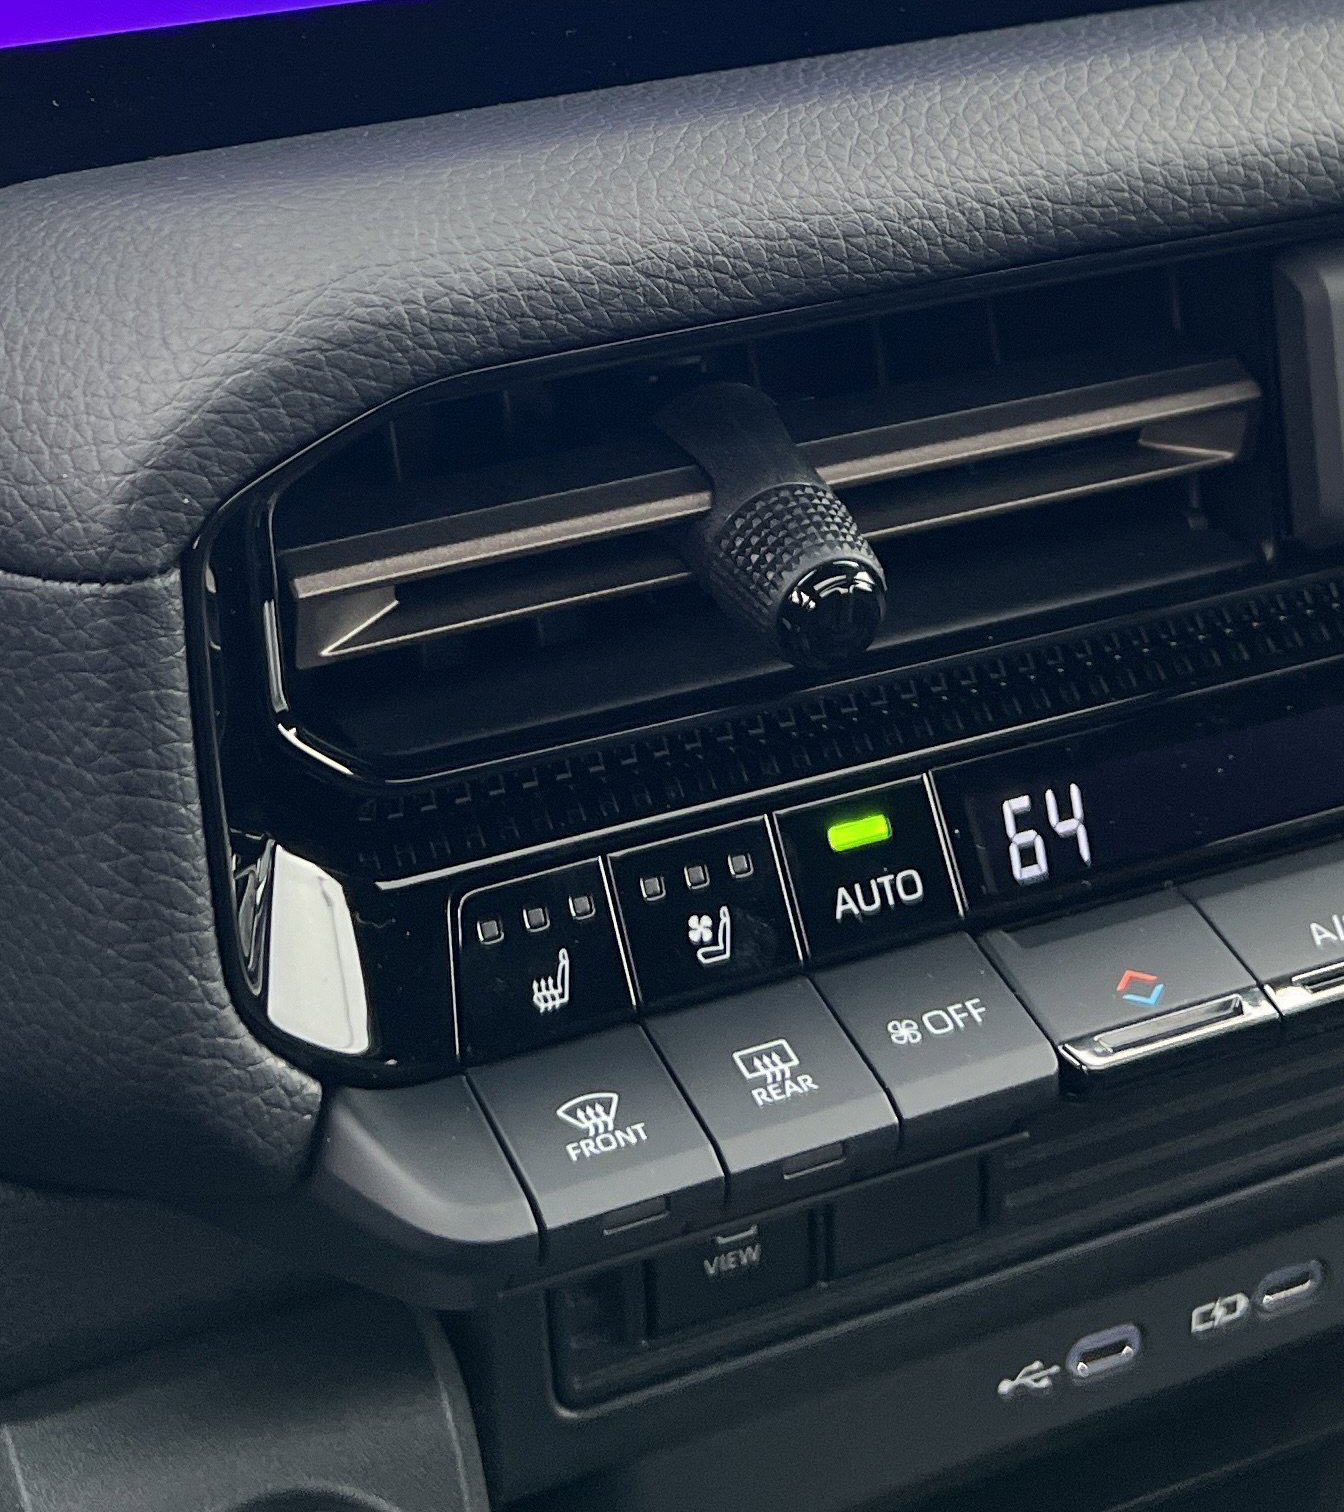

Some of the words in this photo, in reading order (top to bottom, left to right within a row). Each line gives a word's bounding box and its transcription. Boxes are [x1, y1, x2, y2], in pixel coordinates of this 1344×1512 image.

[1001, 783, 1092, 885] 64
[834, 868, 925, 919] AUTO
[922, 997, 987, 1038] OFF
[751, 1073, 818, 1106] REAR
[566, 1122, 648, 1161] FRONT
[703, 1243, 762, 1276] VIEW
